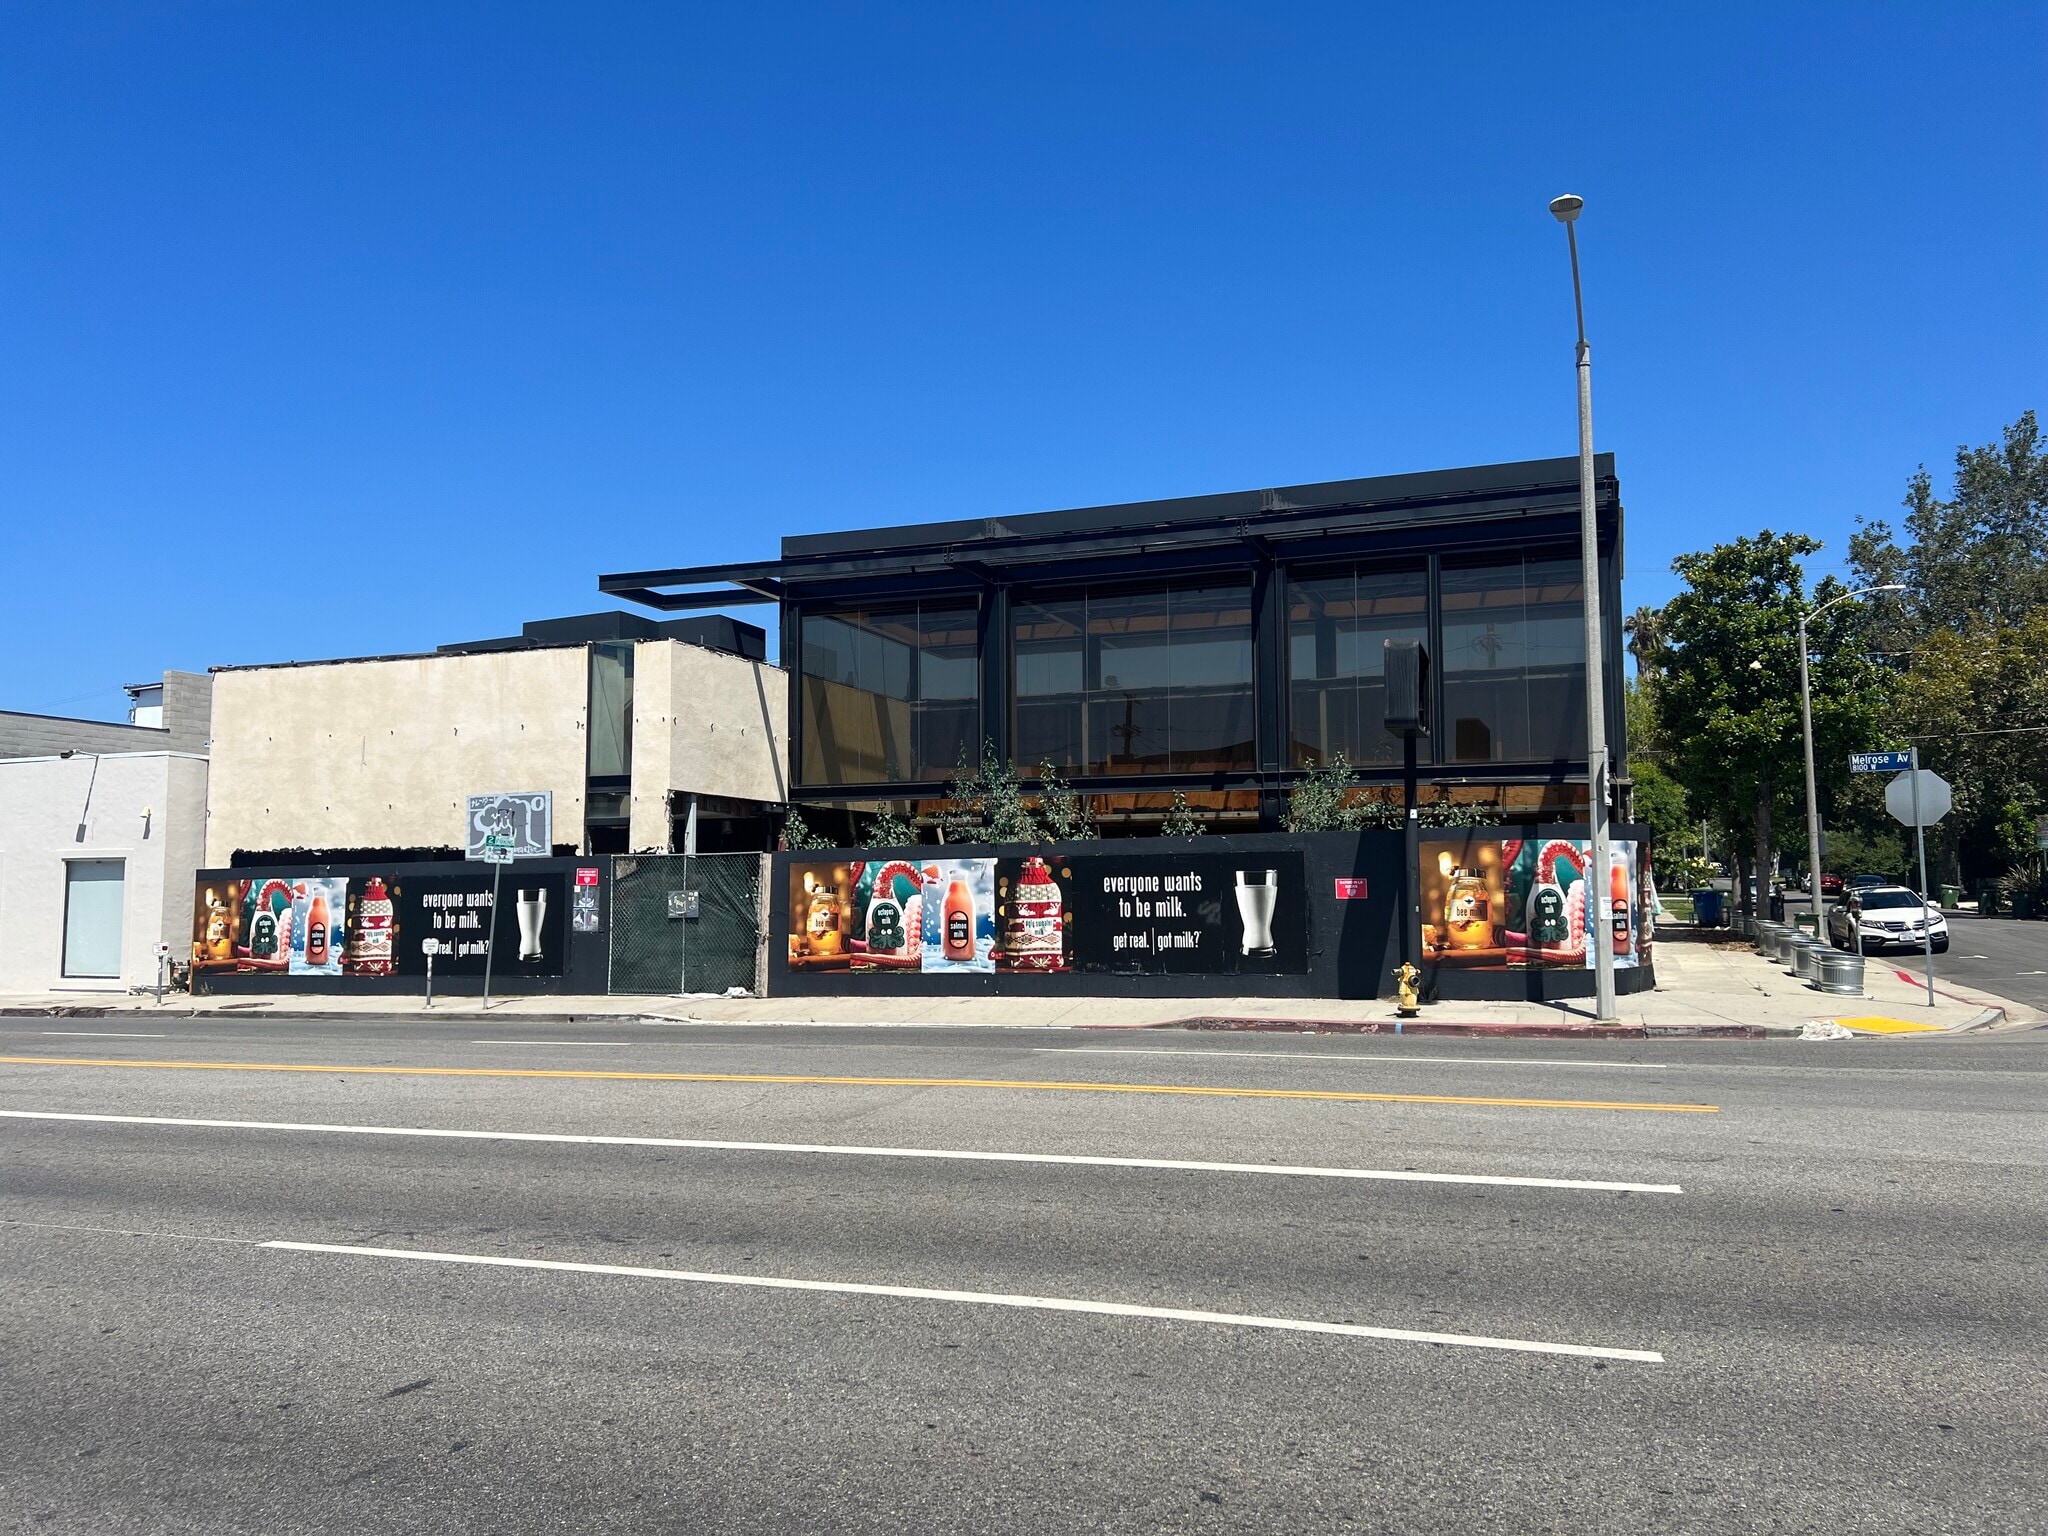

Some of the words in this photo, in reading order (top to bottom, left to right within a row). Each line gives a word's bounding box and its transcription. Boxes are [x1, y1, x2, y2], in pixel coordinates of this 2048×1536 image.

[1851, 755, 1889, 765] Melrose
[1897, 753, 1908, 763] Av
[1103, 875, 1159, 896] everyone
[1164, 871, 1202, 892] wants
[423, 893, 463, 911] everyone
[466, 889, 493, 907] wants
[1118, 897, 1131, 918] to
[1136, 896, 1151, 918] be
[1155, 896, 1187, 918] milk.
[433, 911, 442, 929] to
[444, 910, 456, 929] be
[458, 910, 481, 929] milk.
[1456, 906, 1467, 916] bee
[950, 922, 967, 930] salmon
[953, 930, 964, 938] milk
[438, 940, 453, 955] real.
[458, 940, 469, 957] got
[470, 940, 489, 955] milk?
[1113, 932, 1128, 951] get
[1129, 931, 1150, 948] real.
[1157, 931, 1172, 951] got
[1174, 930, 1200, 948] milk?
